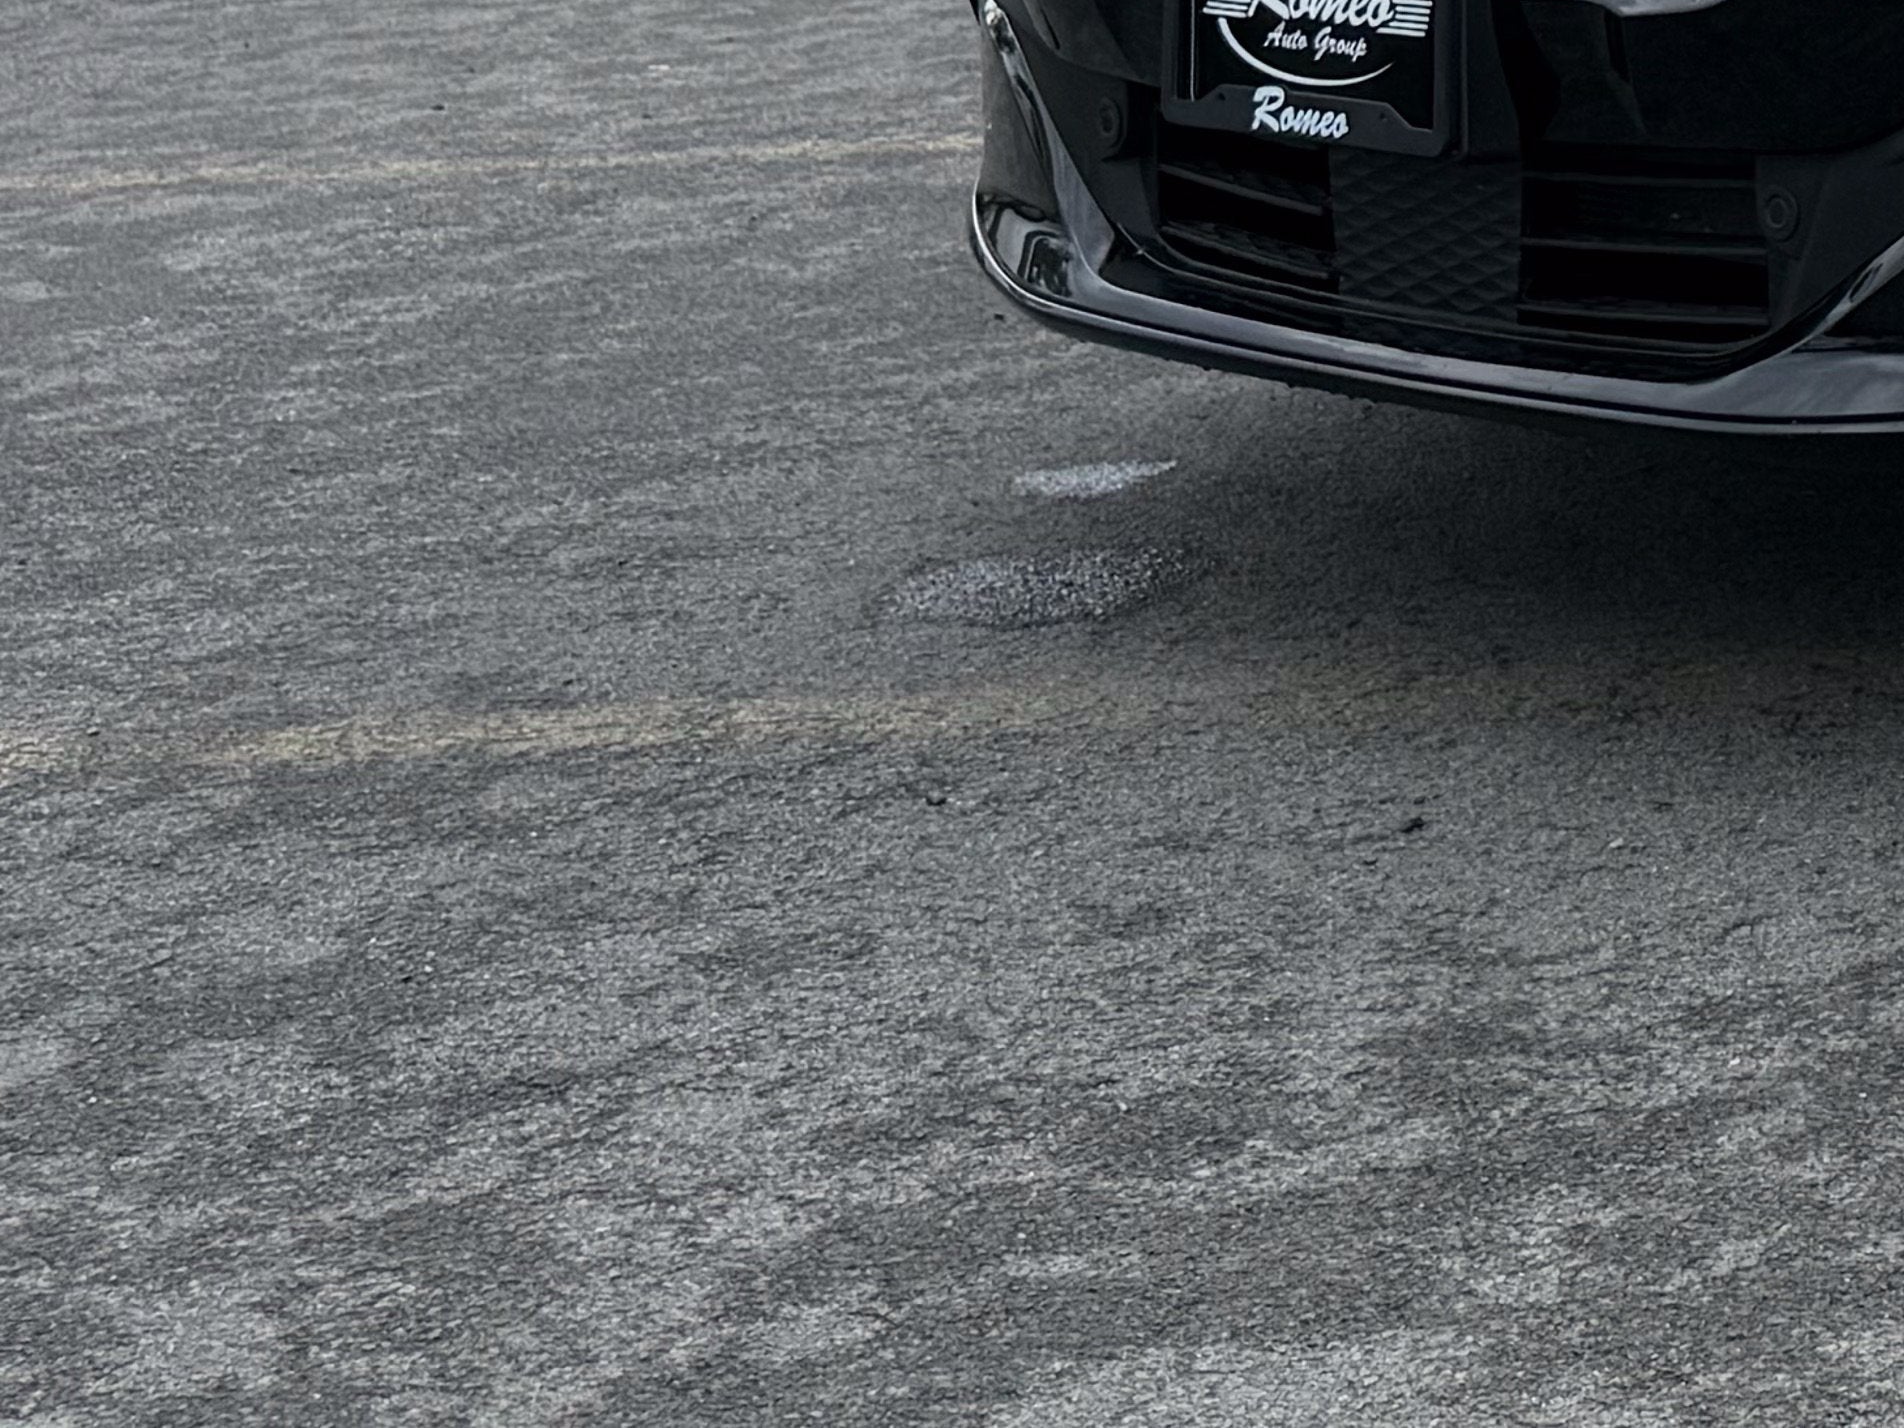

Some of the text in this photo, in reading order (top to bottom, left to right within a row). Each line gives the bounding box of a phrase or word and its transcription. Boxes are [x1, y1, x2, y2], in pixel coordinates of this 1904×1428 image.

[1264, 22, 1367, 62] Auto Group
[1251, 85, 1349, 139] Romeo
